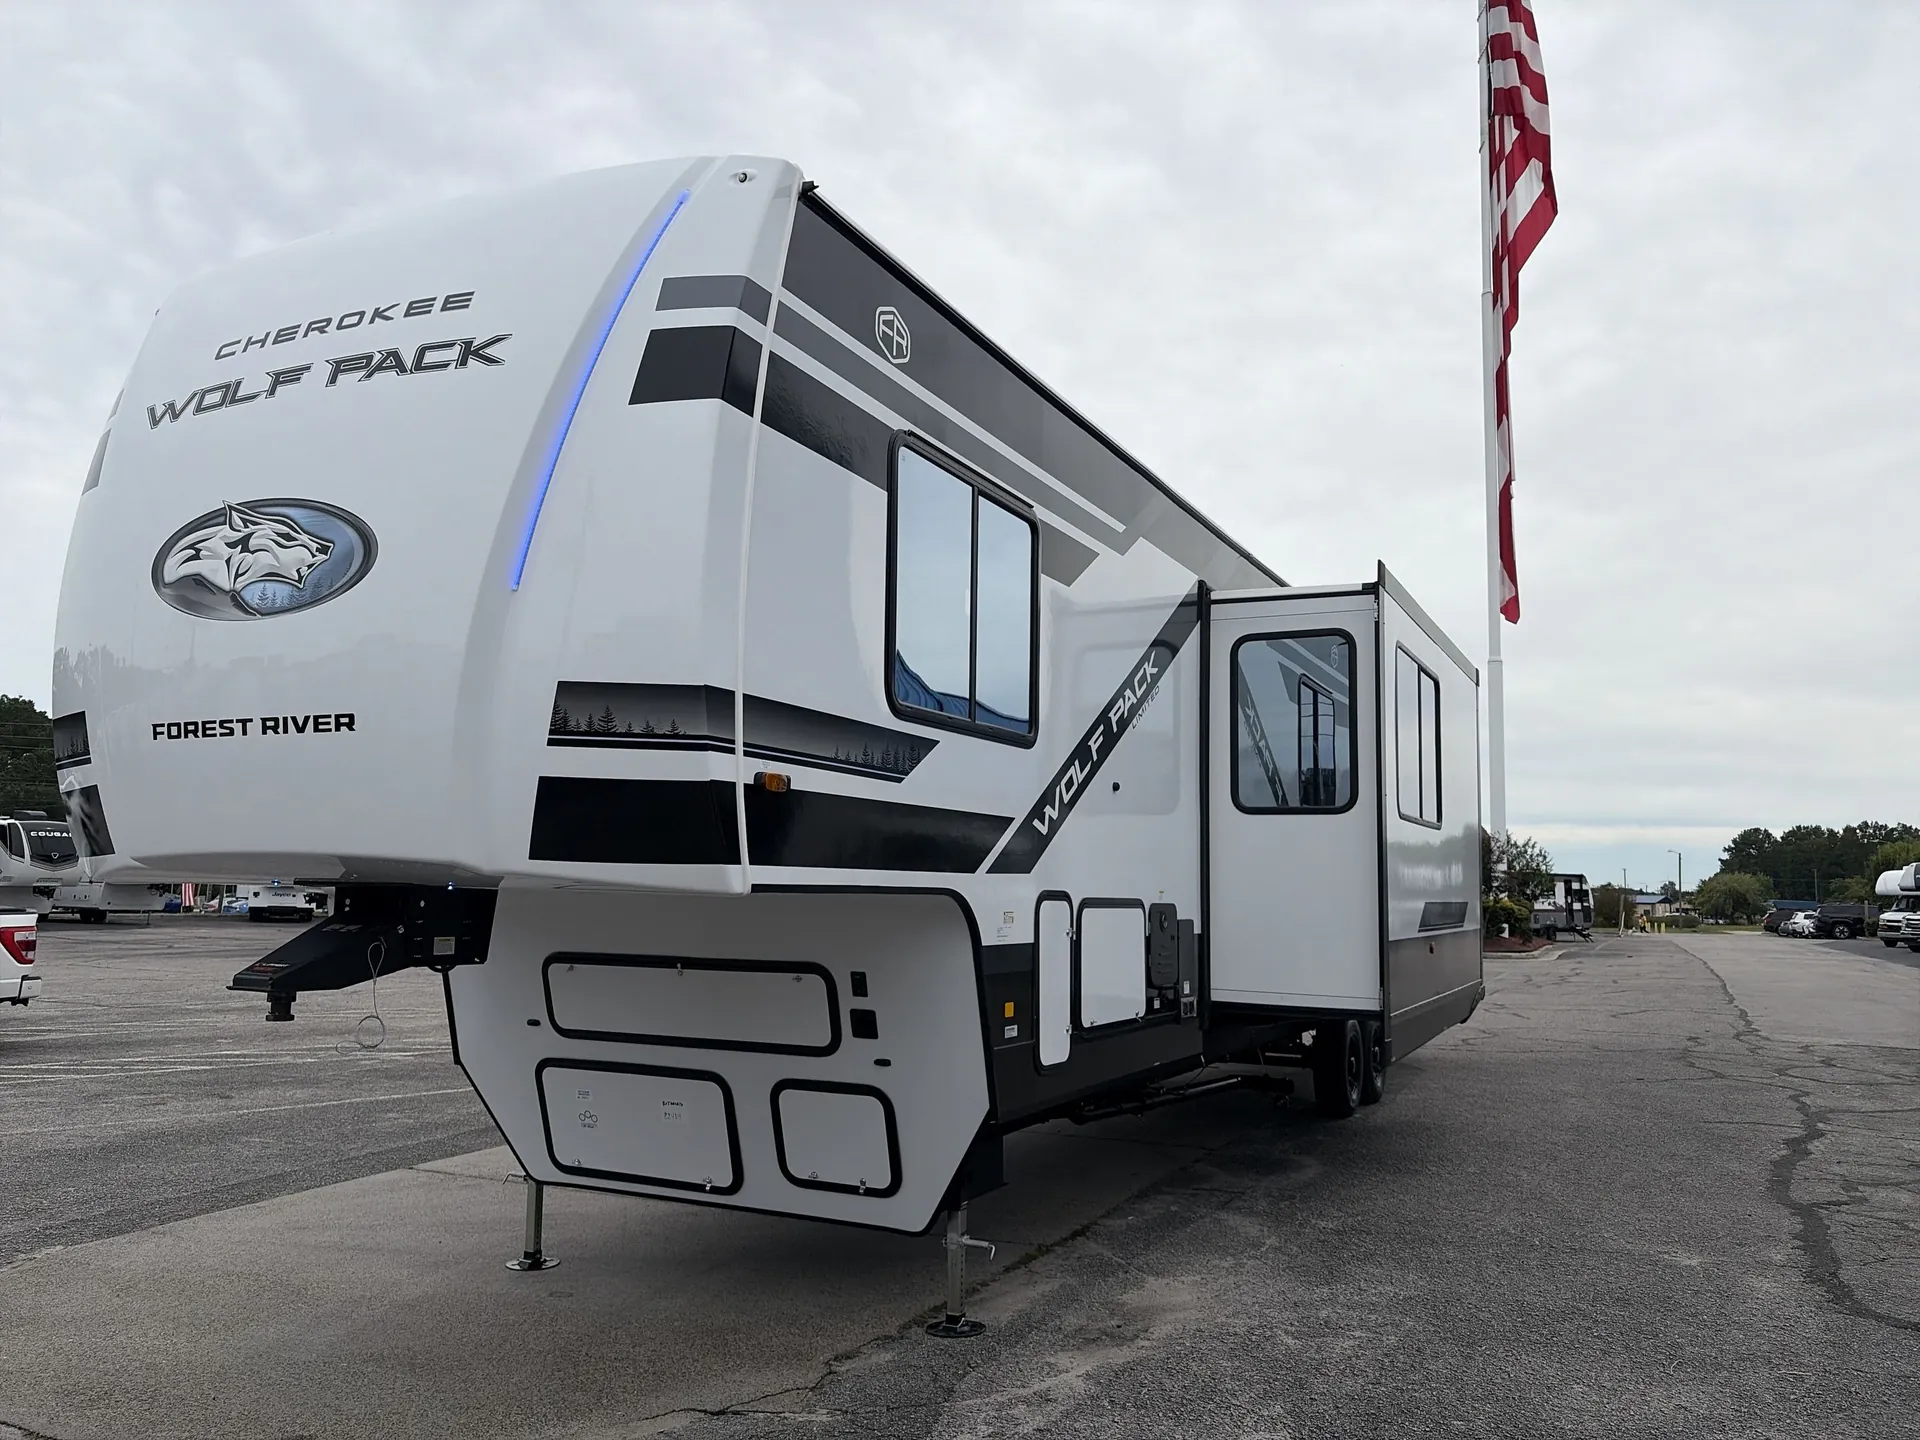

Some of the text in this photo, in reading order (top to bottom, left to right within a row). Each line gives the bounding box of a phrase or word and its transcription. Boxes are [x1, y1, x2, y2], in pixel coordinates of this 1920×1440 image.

[214, 291, 476, 360] CHEROKEE
[147, 333, 513, 430] WOLF PACK
[151, 712, 356, 741] FOREST RIVER
[1131, 685, 1160, 730] LIMITED
[1032, 650, 1159, 836] WOLF PACK
